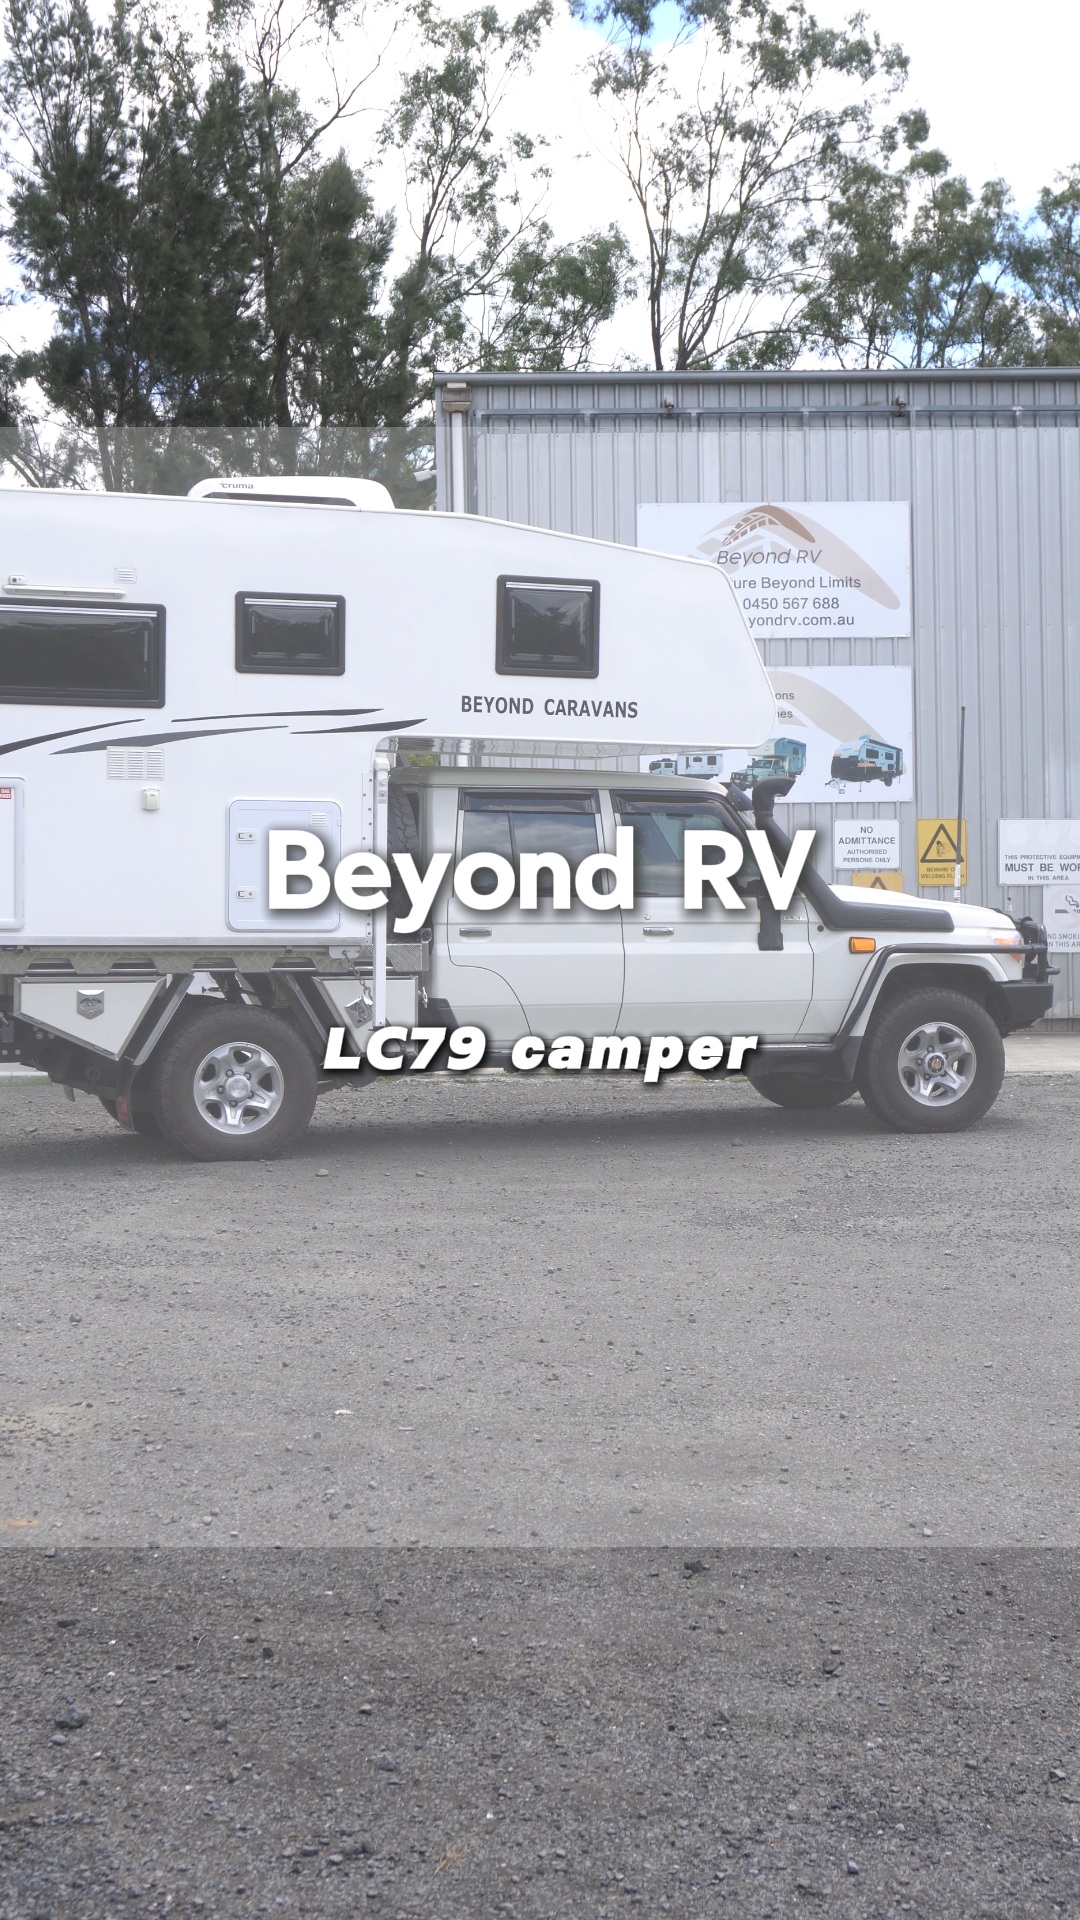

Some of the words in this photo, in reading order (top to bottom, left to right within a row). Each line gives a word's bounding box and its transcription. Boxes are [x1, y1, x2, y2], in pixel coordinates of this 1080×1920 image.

[219, 481, 254, 489] truma
[717, 549, 791, 567] Beyond
[796, 550, 822, 564] RV
[730, 577, 757, 589] ure
[761, 577, 815, 591] Beyond
[819, 576, 861, 588] Limits
[743, 598, 778, 610] 0450
[782, 598, 808, 610] 567
[812, 597, 840, 609] 688
[461, 695, 534, 715] BEYOND
[544, 698, 638, 718] CARAVANS
[838, 837, 896, 845] ADMITTANCE
[1004, 863, 1034, 872] MUST
[1039, 863, 1054, 872] BE
